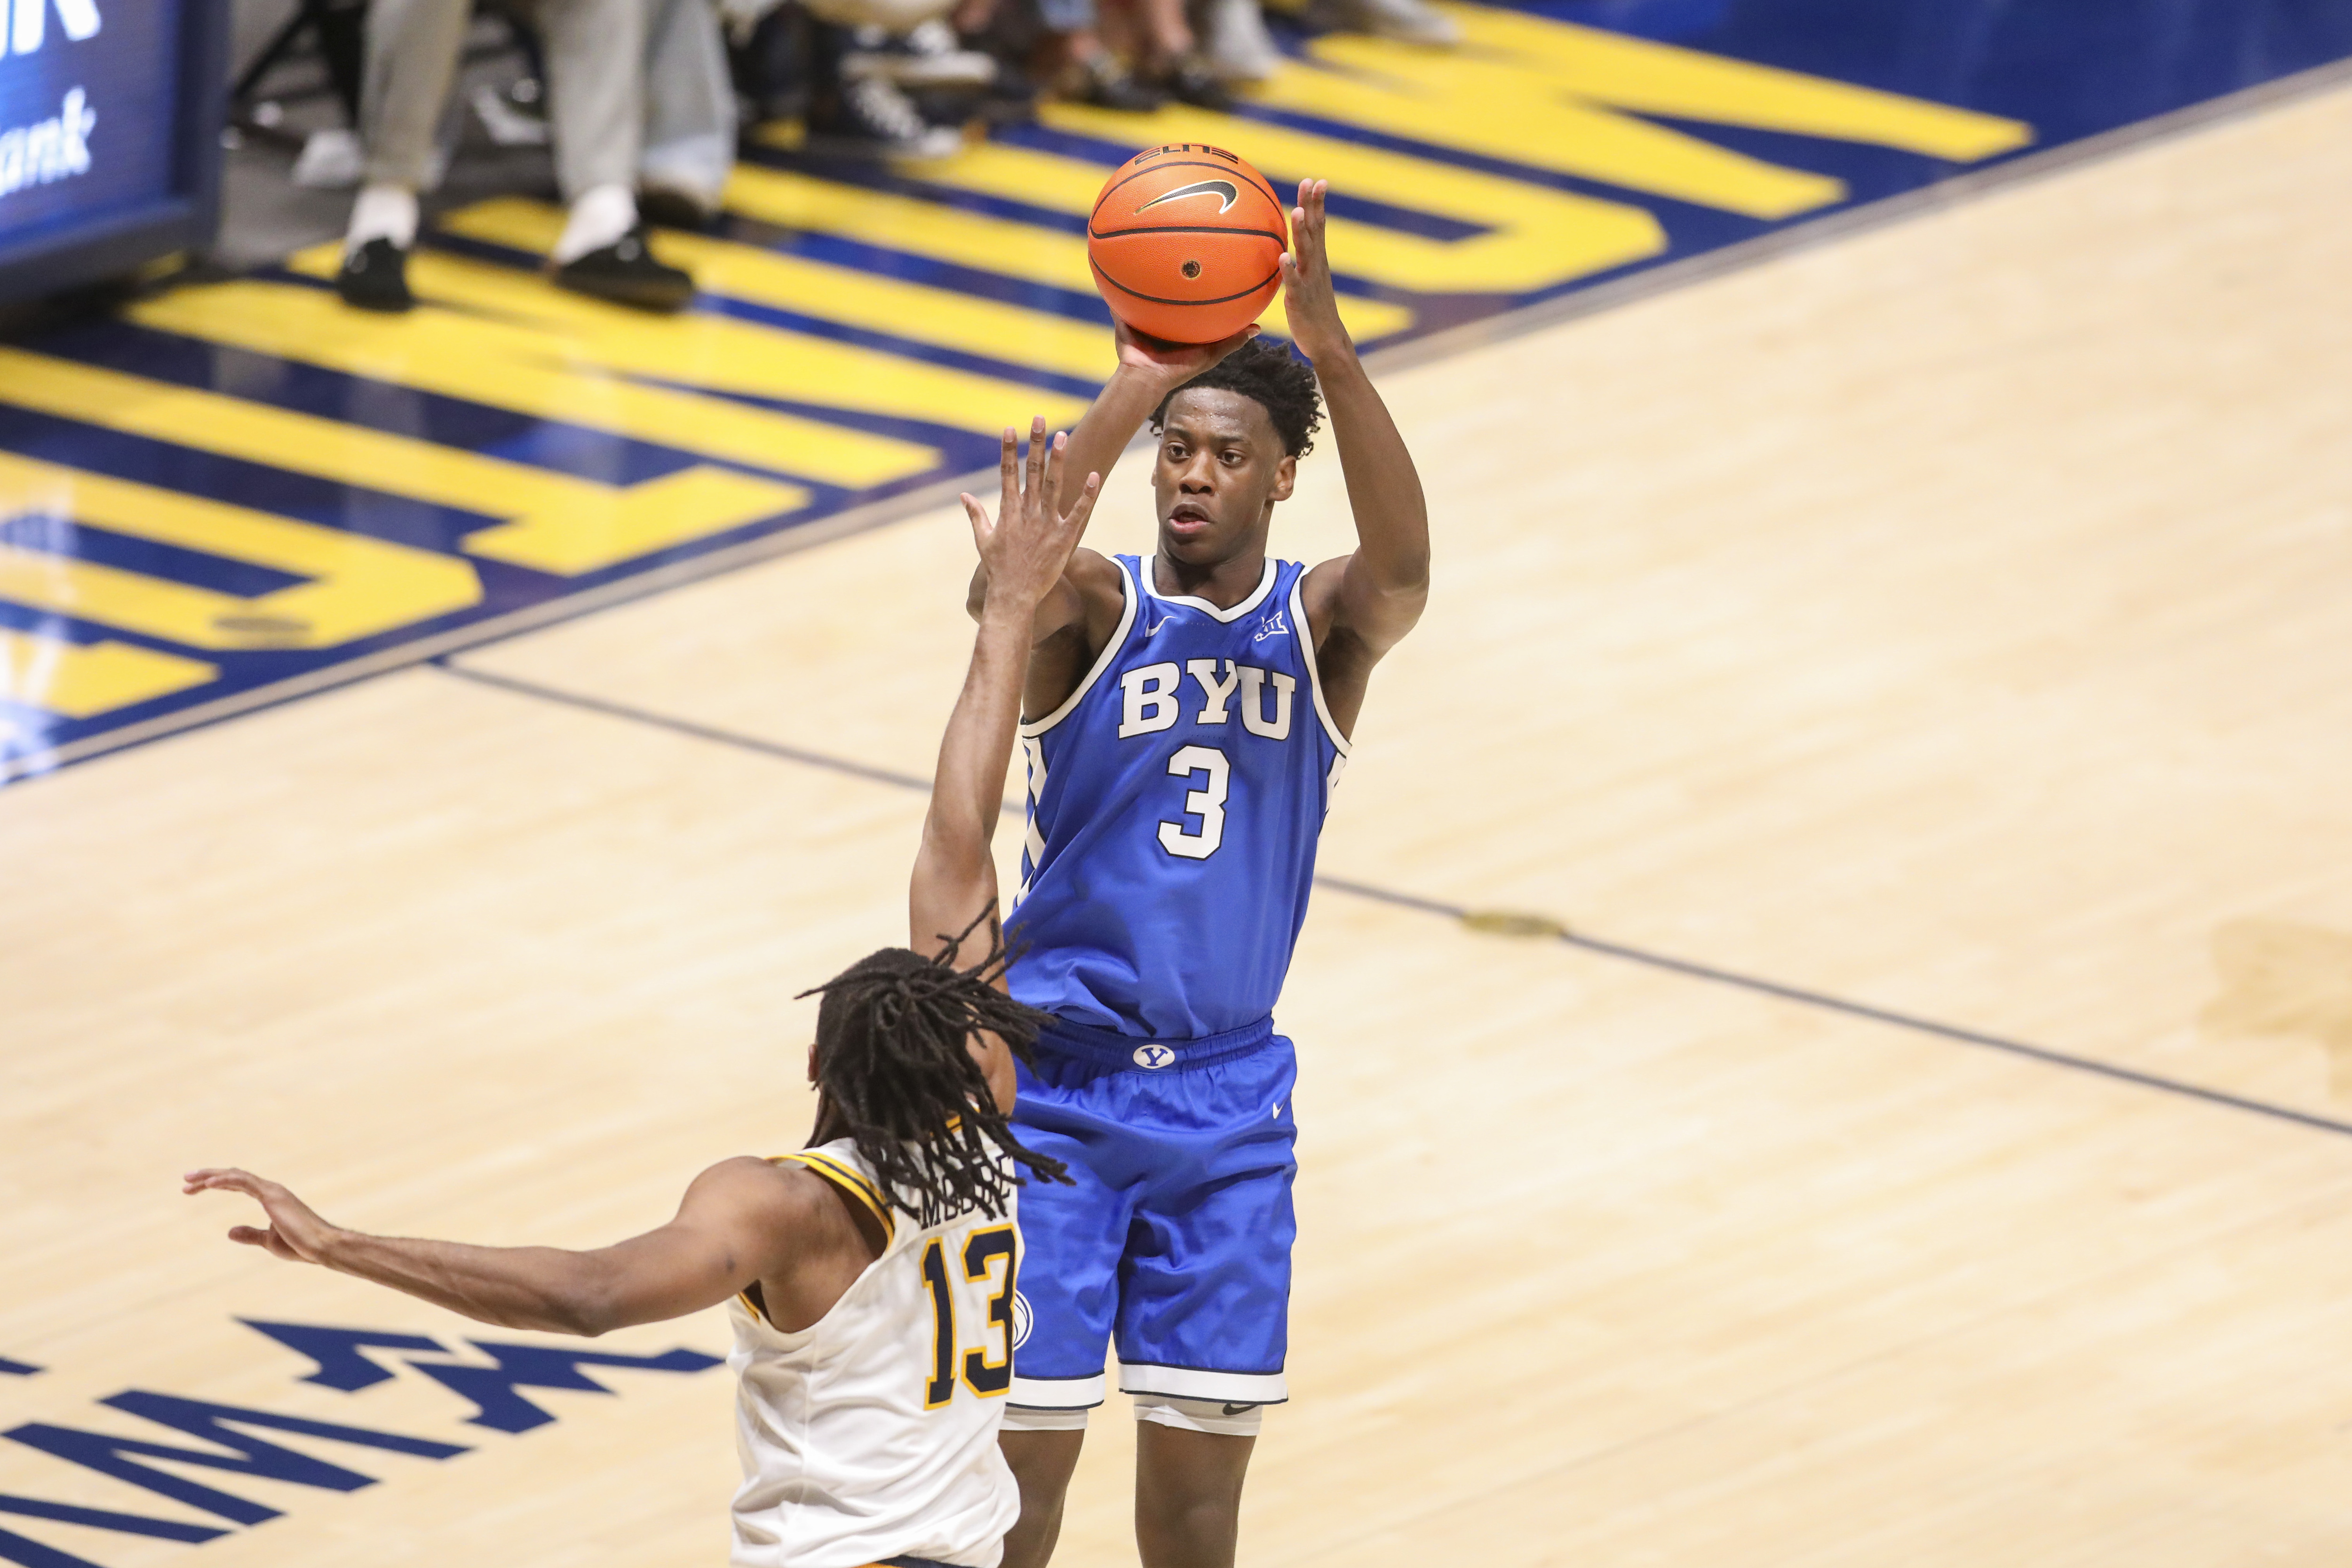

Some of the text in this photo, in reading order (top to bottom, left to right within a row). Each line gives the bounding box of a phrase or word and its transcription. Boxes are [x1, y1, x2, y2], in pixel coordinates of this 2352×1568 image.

[0, 85, 97, 196] ank
[1118, 658, 1296, 741] BYU
[1156, 745, 1231, 861] 3
[1141, 1047, 1168, 1067] Y
[920, 1223, 1016, 1410] 13
